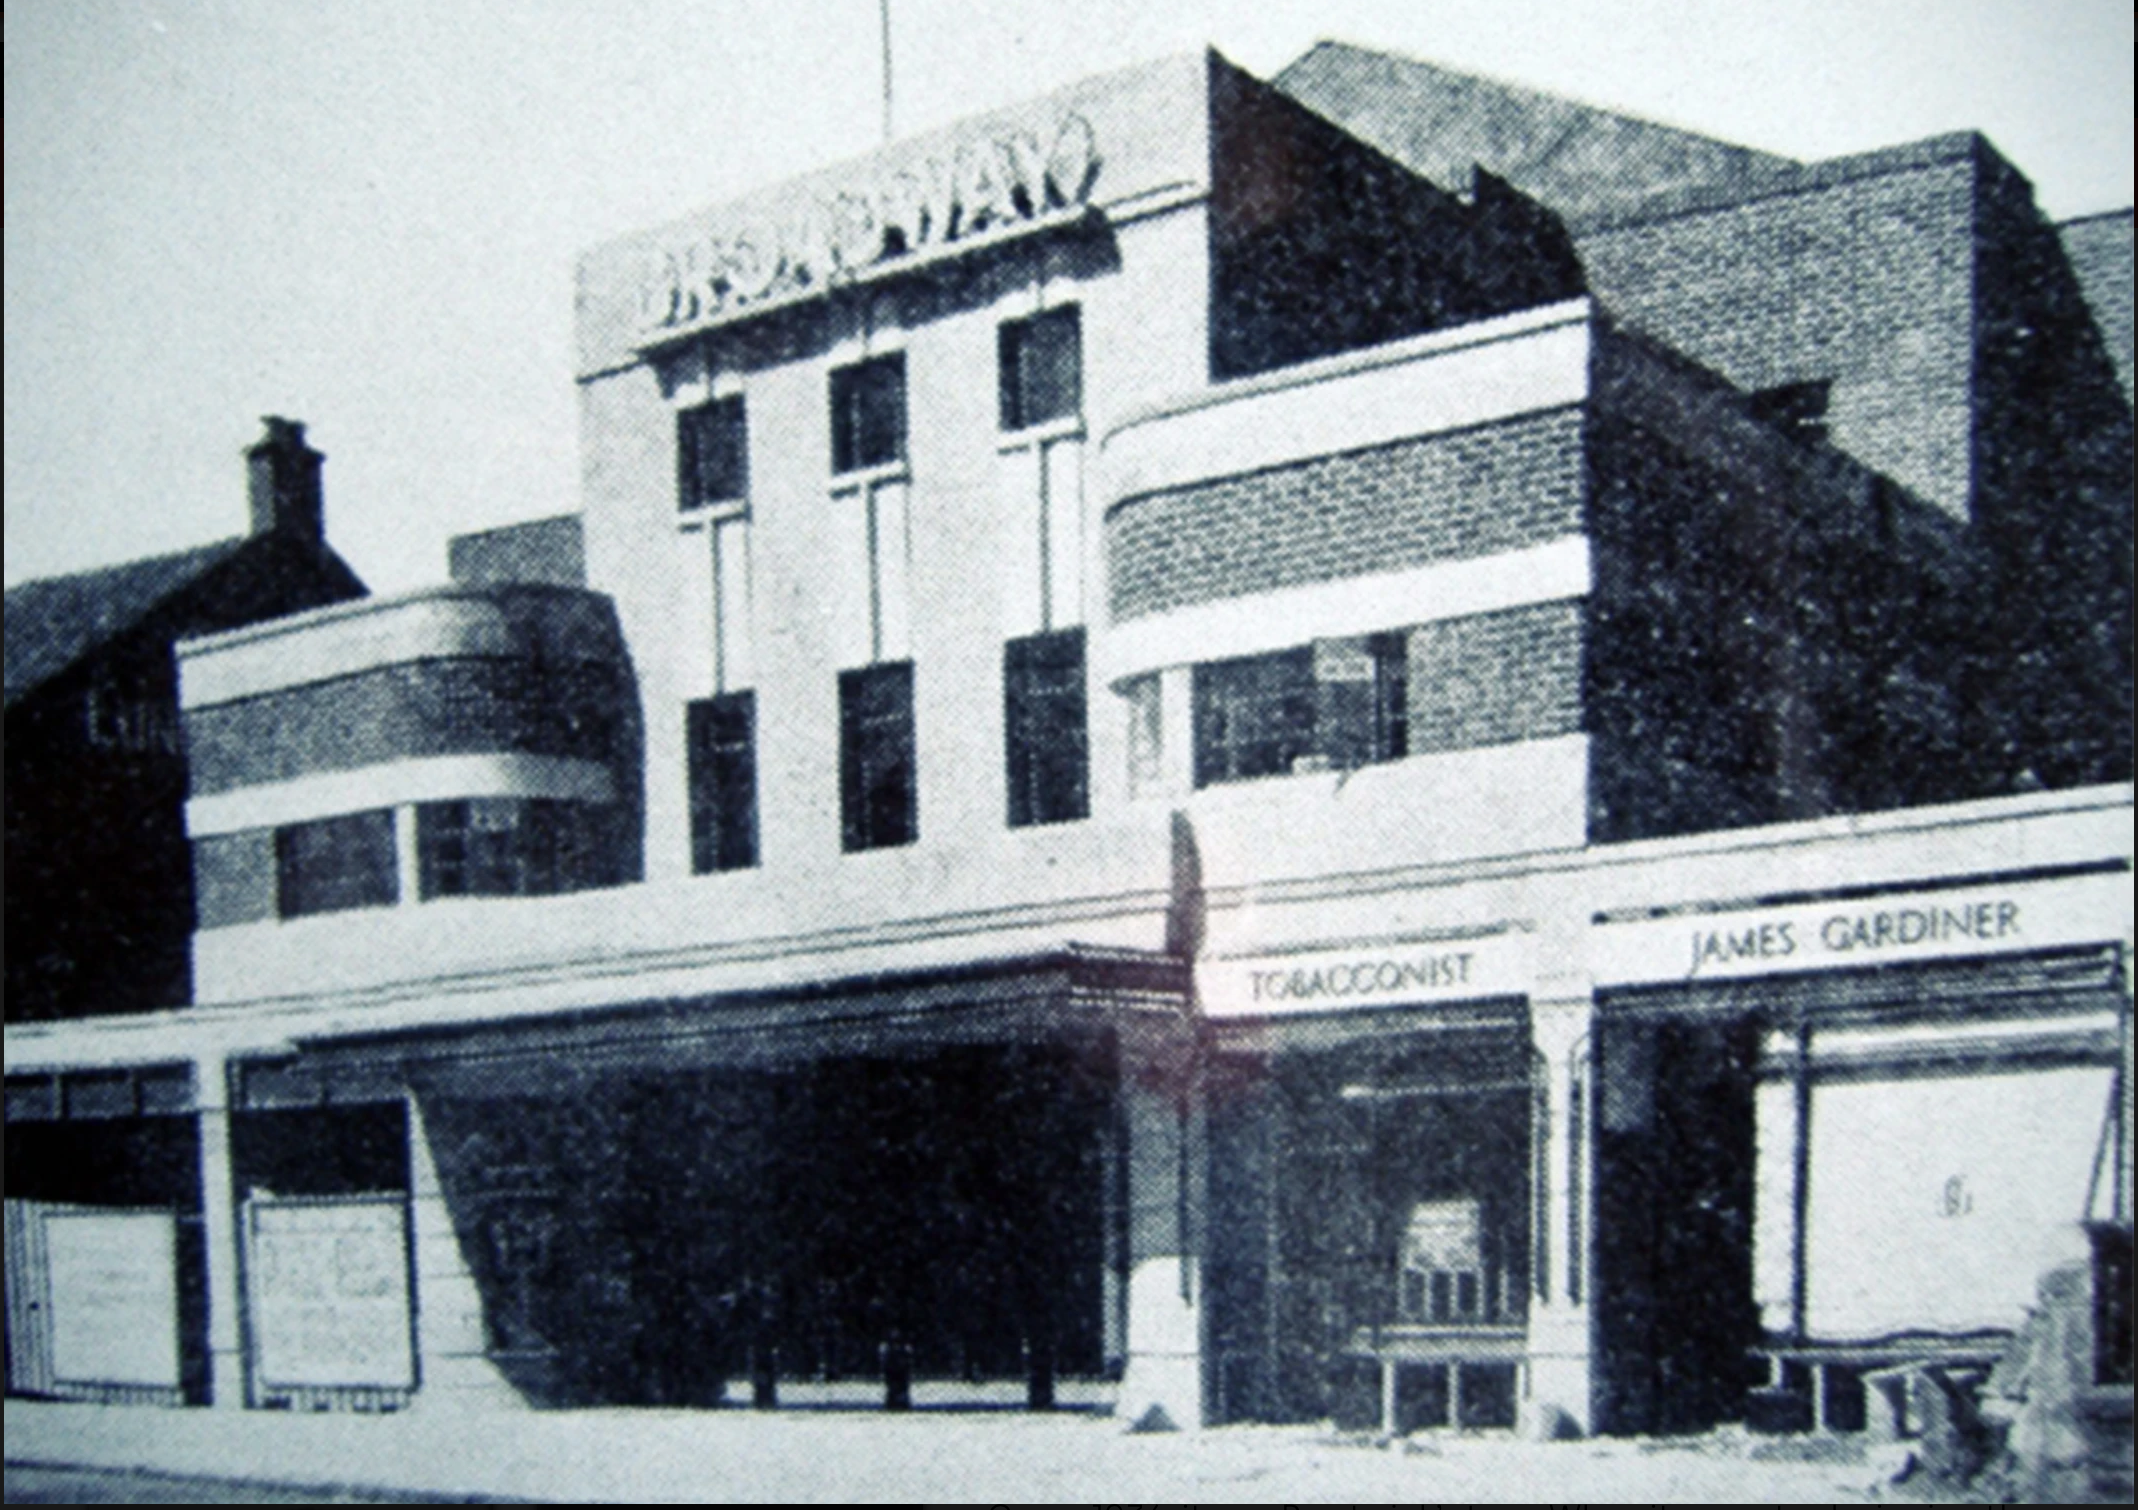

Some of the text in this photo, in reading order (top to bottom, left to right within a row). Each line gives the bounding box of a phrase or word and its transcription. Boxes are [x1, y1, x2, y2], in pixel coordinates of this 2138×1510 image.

[1688, 901, 2021, 978] JAMES GARDINER
[1250, 953, 1475, 1000] TOBACCONIST
